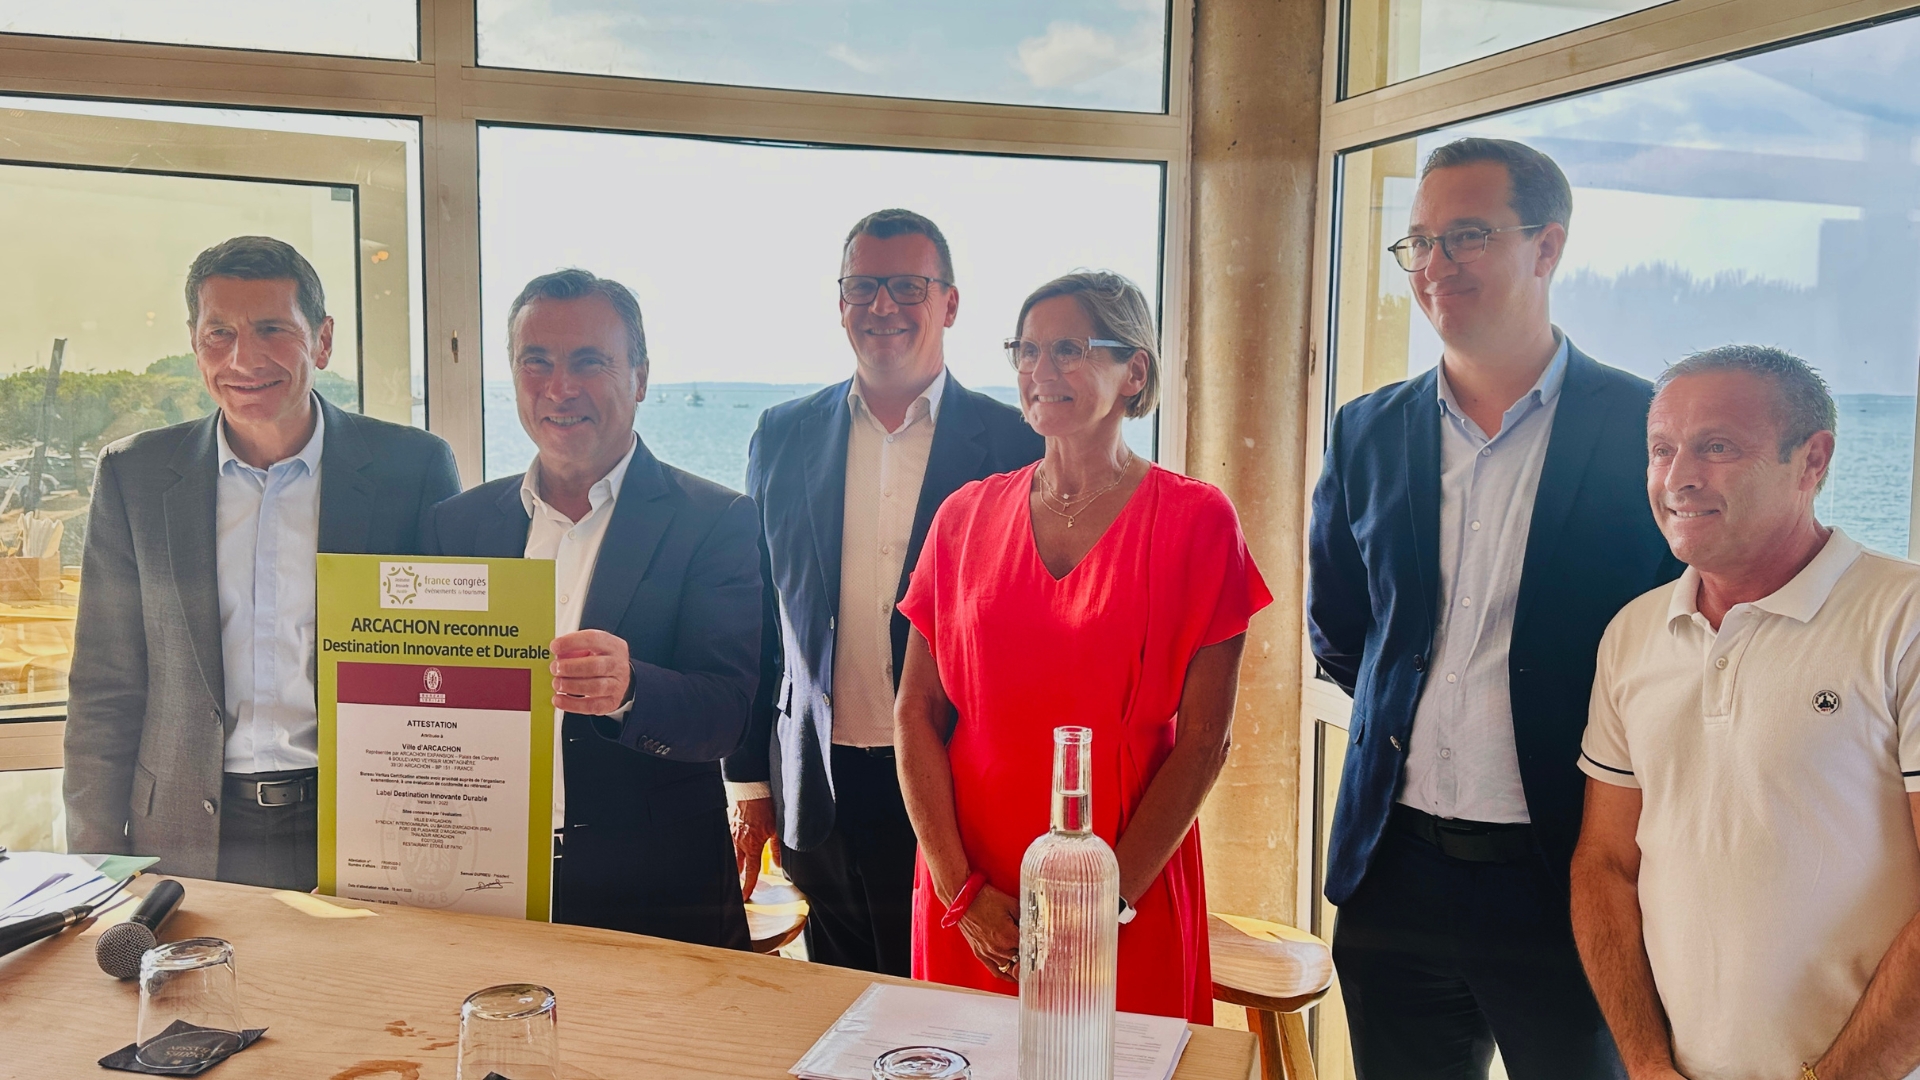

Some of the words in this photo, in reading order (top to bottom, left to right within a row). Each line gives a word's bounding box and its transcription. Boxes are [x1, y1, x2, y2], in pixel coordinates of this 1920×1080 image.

[424, 576, 450, 586] france
[453, 577, 486, 588] congrès
[351, 617, 440, 634] ARCACHON
[444, 622, 519, 638] reconnue
[322, 638, 400, 654] Destination
[403, 642, 473, 657] Innovante
[476, 644, 490, 658] et
[494, 644, 550, 660] Durable
[407, 720, 458, 728] ATTESTATION
[394, 790, 429, 798] Destination
